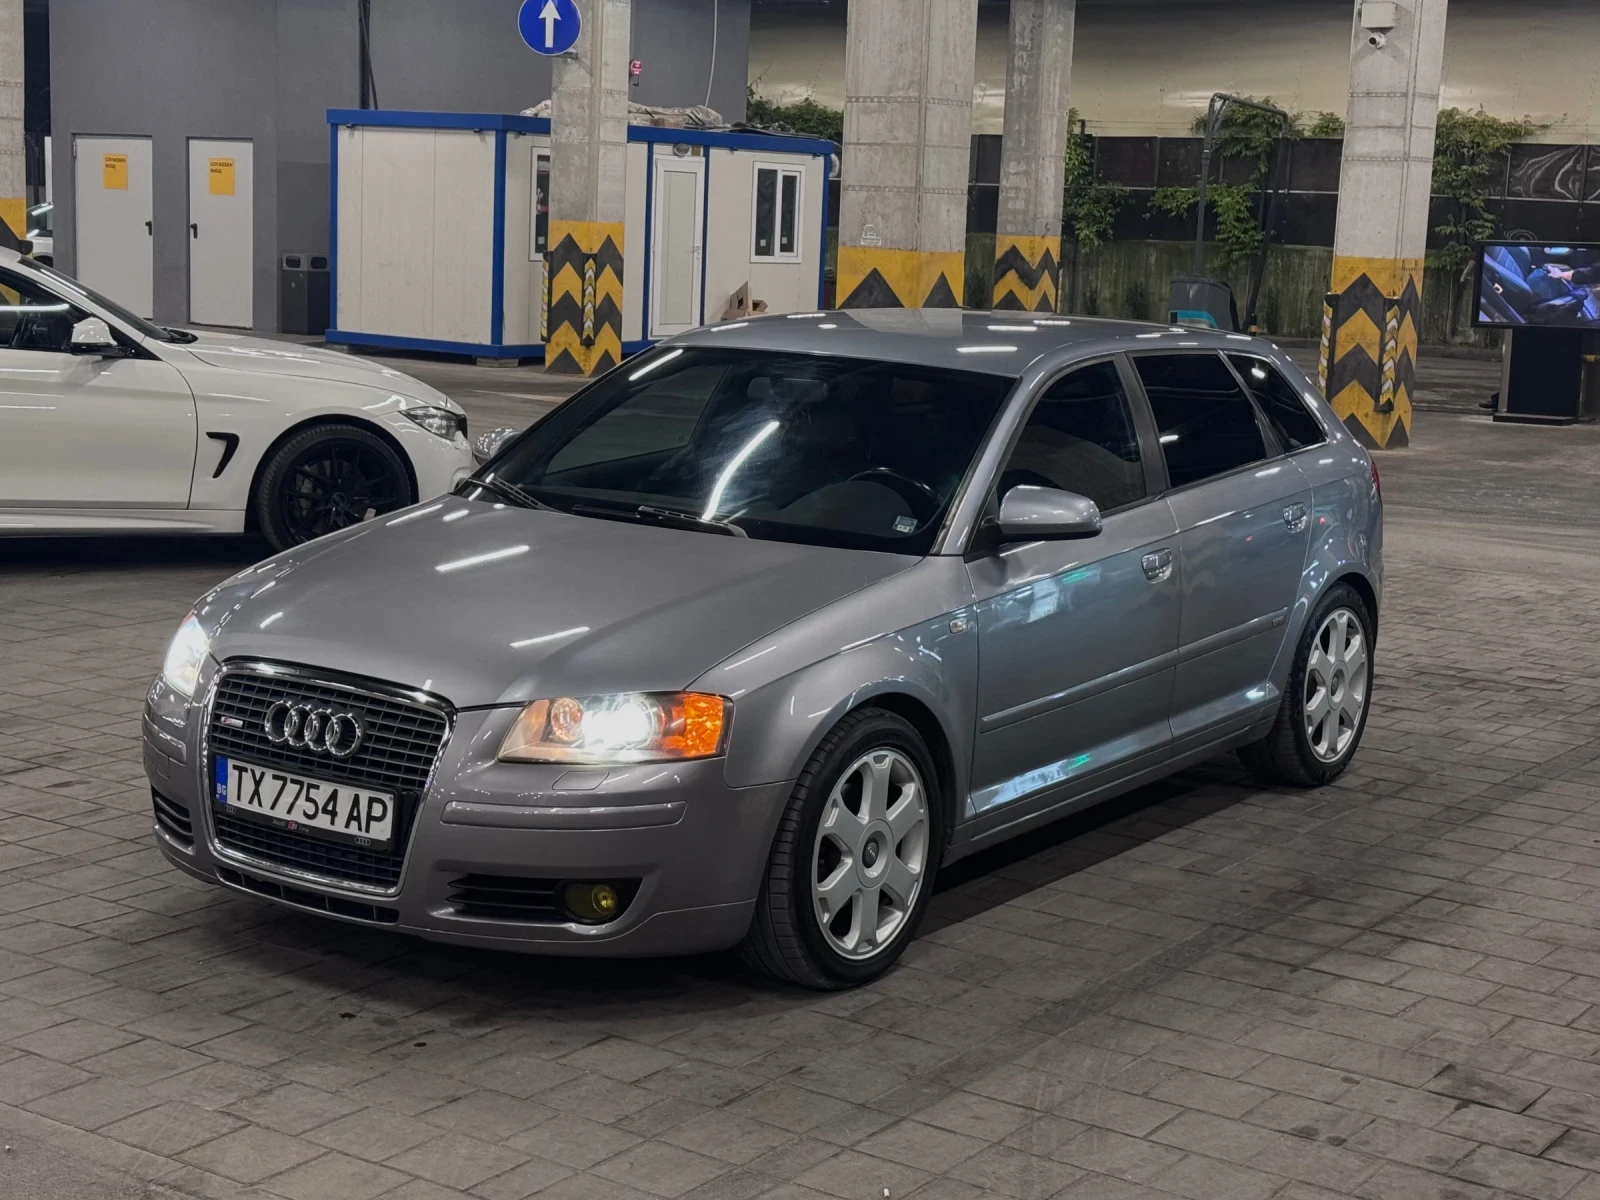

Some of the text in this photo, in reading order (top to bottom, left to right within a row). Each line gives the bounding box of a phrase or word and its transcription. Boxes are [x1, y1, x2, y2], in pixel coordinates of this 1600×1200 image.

[217, 783, 227, 796] BG
[232, 764, 388, 834] TX 7754 AP
